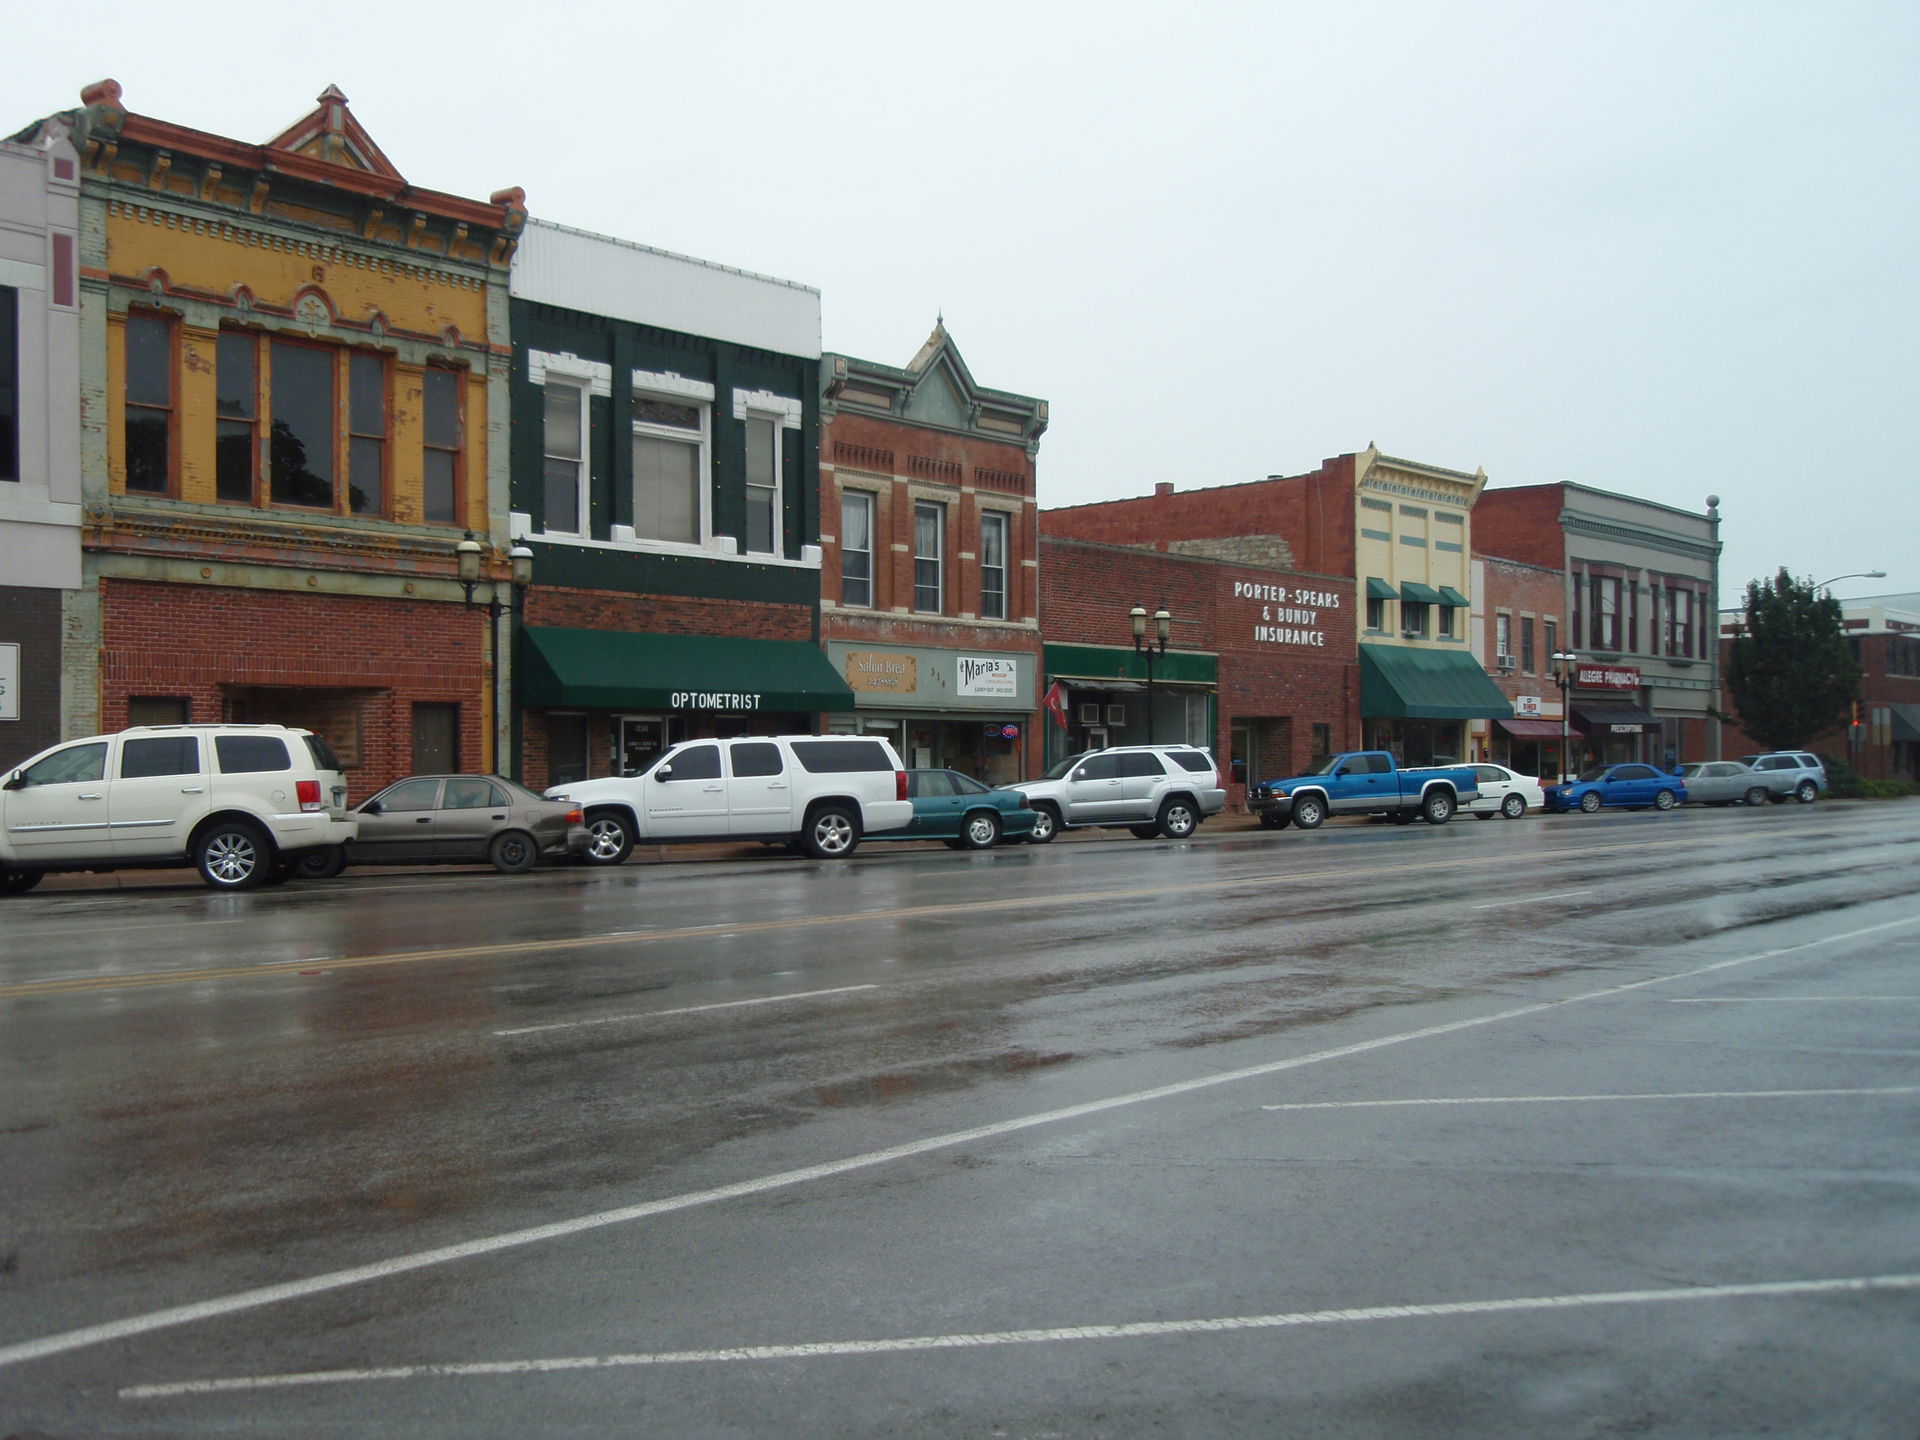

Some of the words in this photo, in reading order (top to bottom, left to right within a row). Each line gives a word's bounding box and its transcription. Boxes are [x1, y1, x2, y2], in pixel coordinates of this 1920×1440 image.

[1262, 605, 1270, 621] &
[1277, 607, 1317, 625] BUNDY
[1254, 626, 1324, 646] INSURANCE
[858, 654, 883, 673] Salon
[965, 659, 1000, 686] Maria's
[1579, 669, 1603, 682] ALLEGRE
[671, 692, 761, 710] OPTOMETRIST
